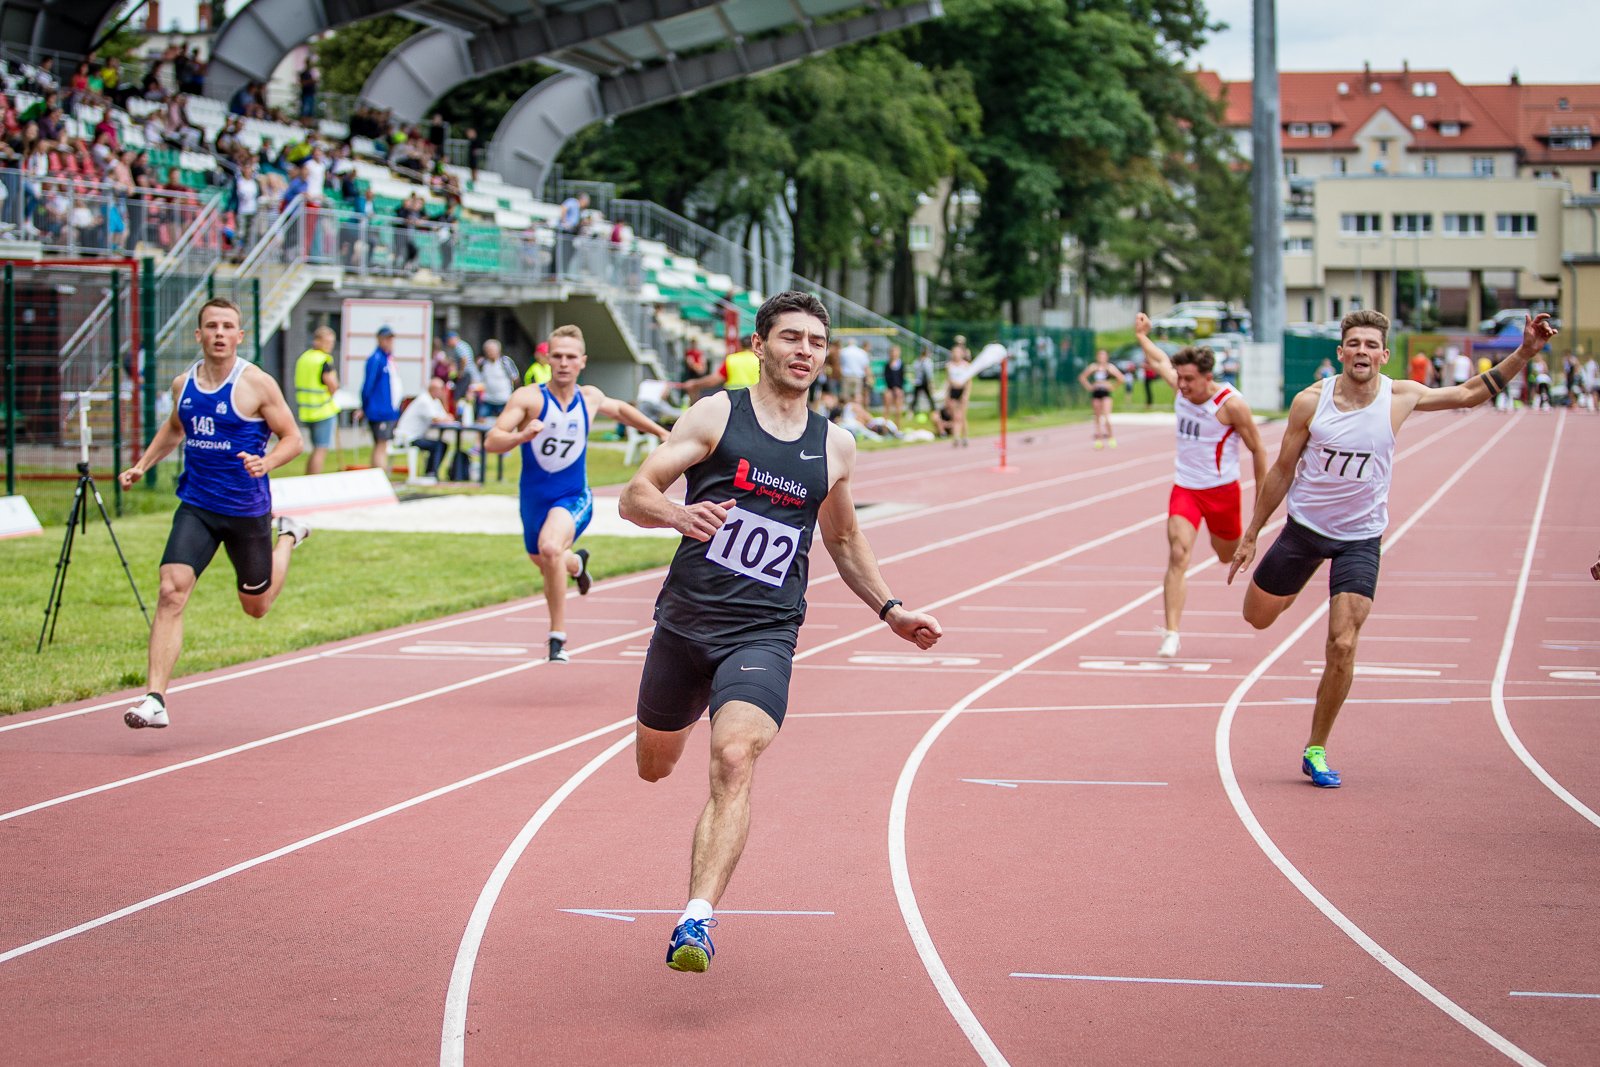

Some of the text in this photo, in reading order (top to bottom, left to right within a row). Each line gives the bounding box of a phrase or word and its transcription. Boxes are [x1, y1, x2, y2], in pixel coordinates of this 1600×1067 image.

[190, 415, 215, 436] 140
[541, 436, 576, 459] 67
[1322, 447, 1372, 479] 777
[752, 467, 808, 498] lubelskie
[720, 518, 795, 579] 102
